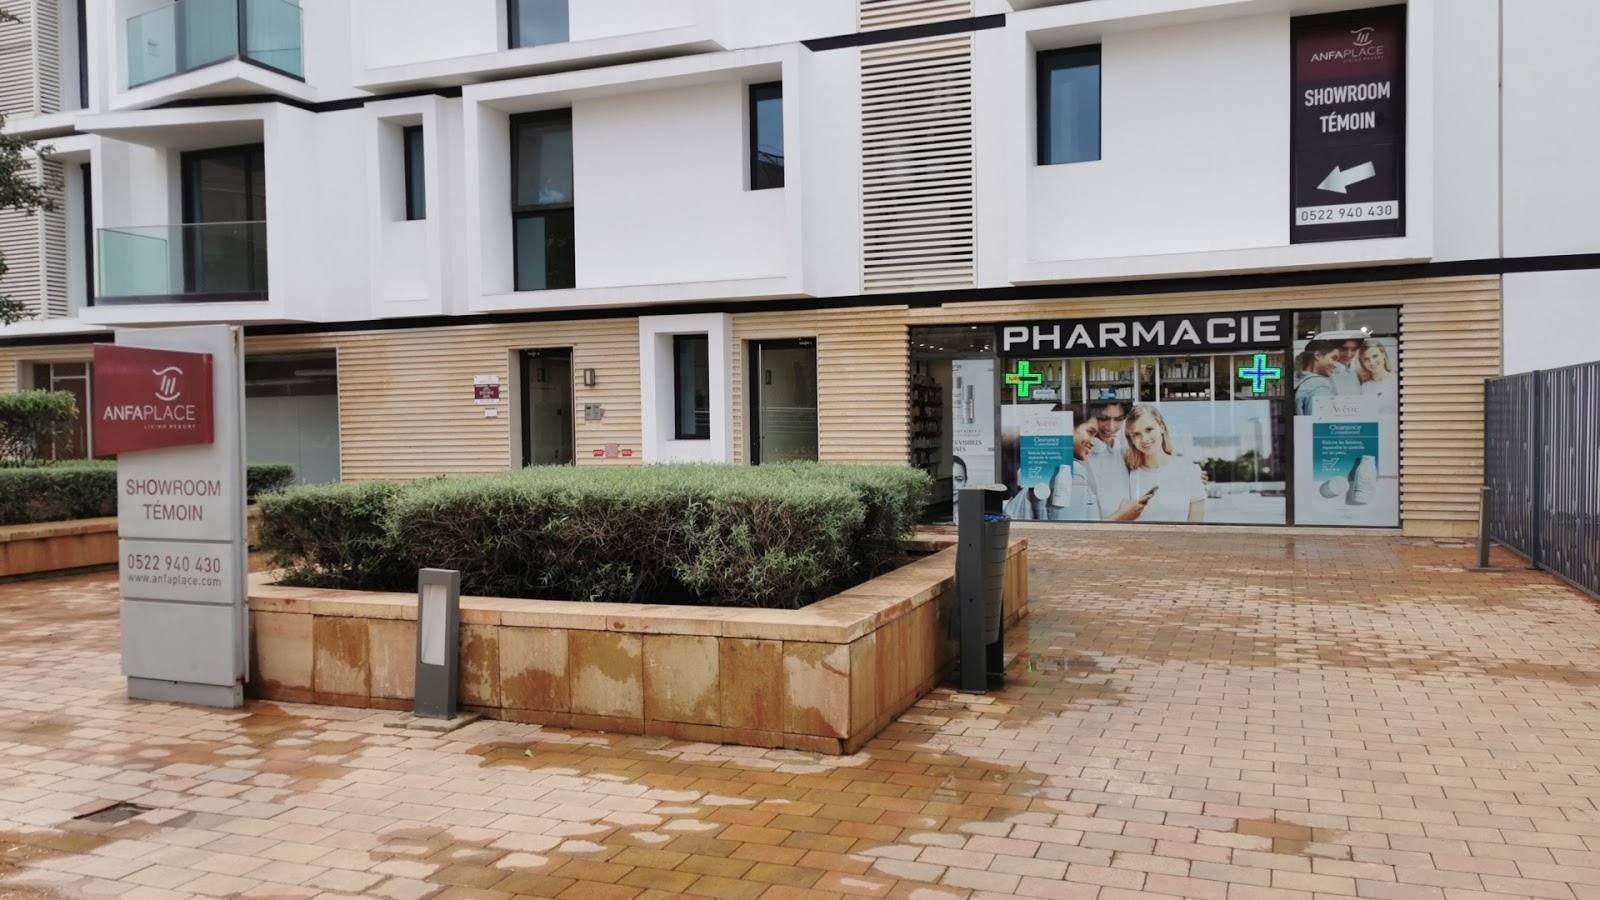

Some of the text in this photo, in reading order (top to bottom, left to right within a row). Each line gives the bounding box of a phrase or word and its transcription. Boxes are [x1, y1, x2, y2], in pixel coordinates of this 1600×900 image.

[1310, 45, 1385, 62] ANFAPLACE
[1304, 81, 1391, 106] SHOWROOM
[1320, 111, 1376, 133] TÉMOIN
[1301, 205, 1393, 222] 0522 940 430
[1003, 315, 1281, 351] PHARMACIE
[103, 404, 196, 421] ANFAPLACE
[126, 479, 221, 496] SHOWROOM
[143, 500, 203, 520] TÉMOIN
[127, 554, 221, 573] 0522 940 430
[127, 573, 222, 587] www.anfaplace.com
